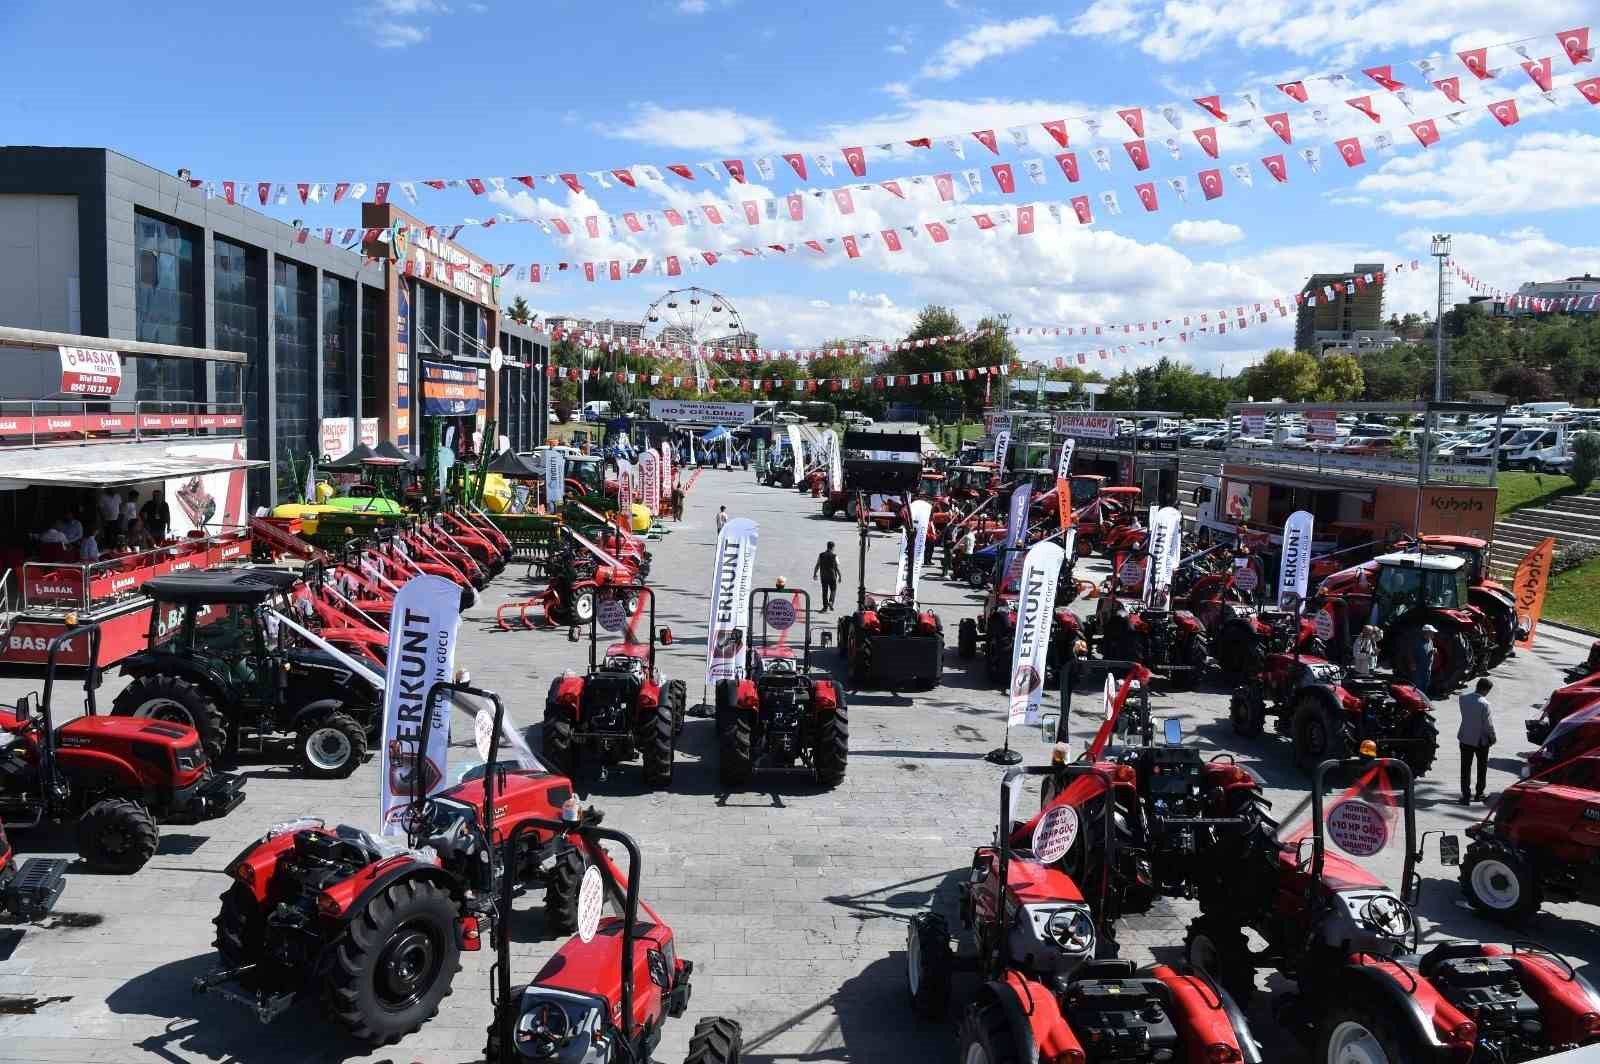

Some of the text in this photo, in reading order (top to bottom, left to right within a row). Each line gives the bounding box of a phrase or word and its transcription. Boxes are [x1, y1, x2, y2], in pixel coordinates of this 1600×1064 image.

[661, 407, 686, 416] HOŞ
[1431, 495, 1483, 511] Kubota
[1284, 527, 1301, 587] ERKUNT
[43, 585, 73, 594] BASAK
[718, 539, 740, 623] ERKUNT
[1519, 553, 1545, 610] Kubota
[1020, 565, 1045, 659] ERKUNT
[396, 607, 431, 743] ERKUNT
[1059, 824, 1075, 835] GÜÇ
[1348, 822, 1360, 831] HP
